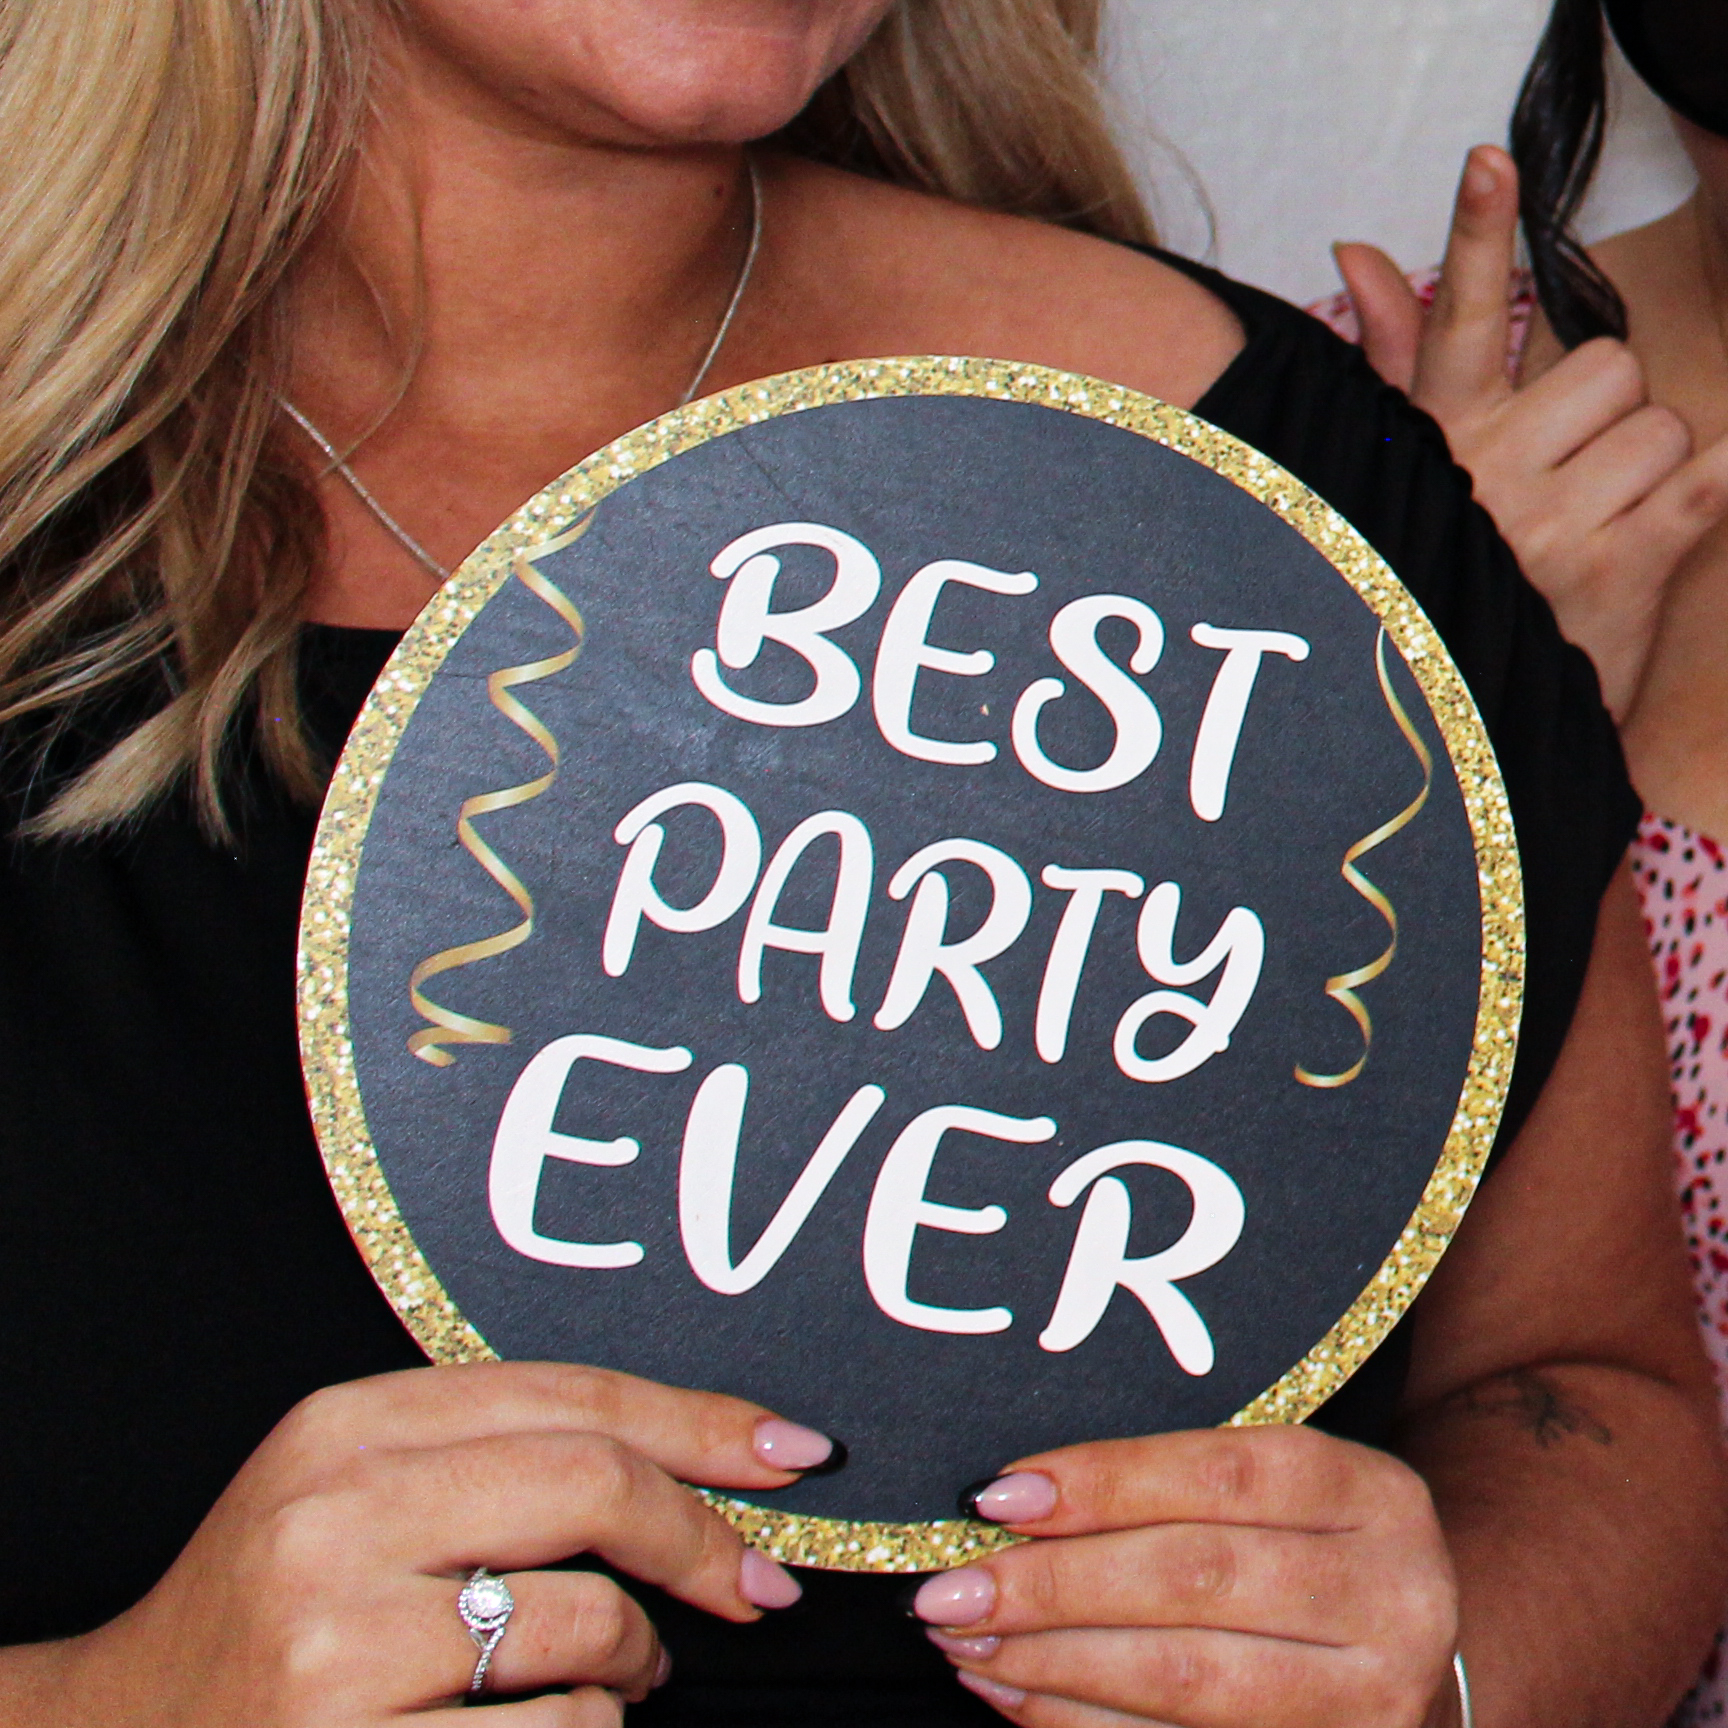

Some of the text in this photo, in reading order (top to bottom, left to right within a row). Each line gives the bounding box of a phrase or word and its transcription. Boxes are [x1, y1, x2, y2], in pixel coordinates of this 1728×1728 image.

[692, 523, 1310, 823] BEST
[604, 783, 1264, 1081] PARTY
[490, 1035, 1245, 1375] EVER
